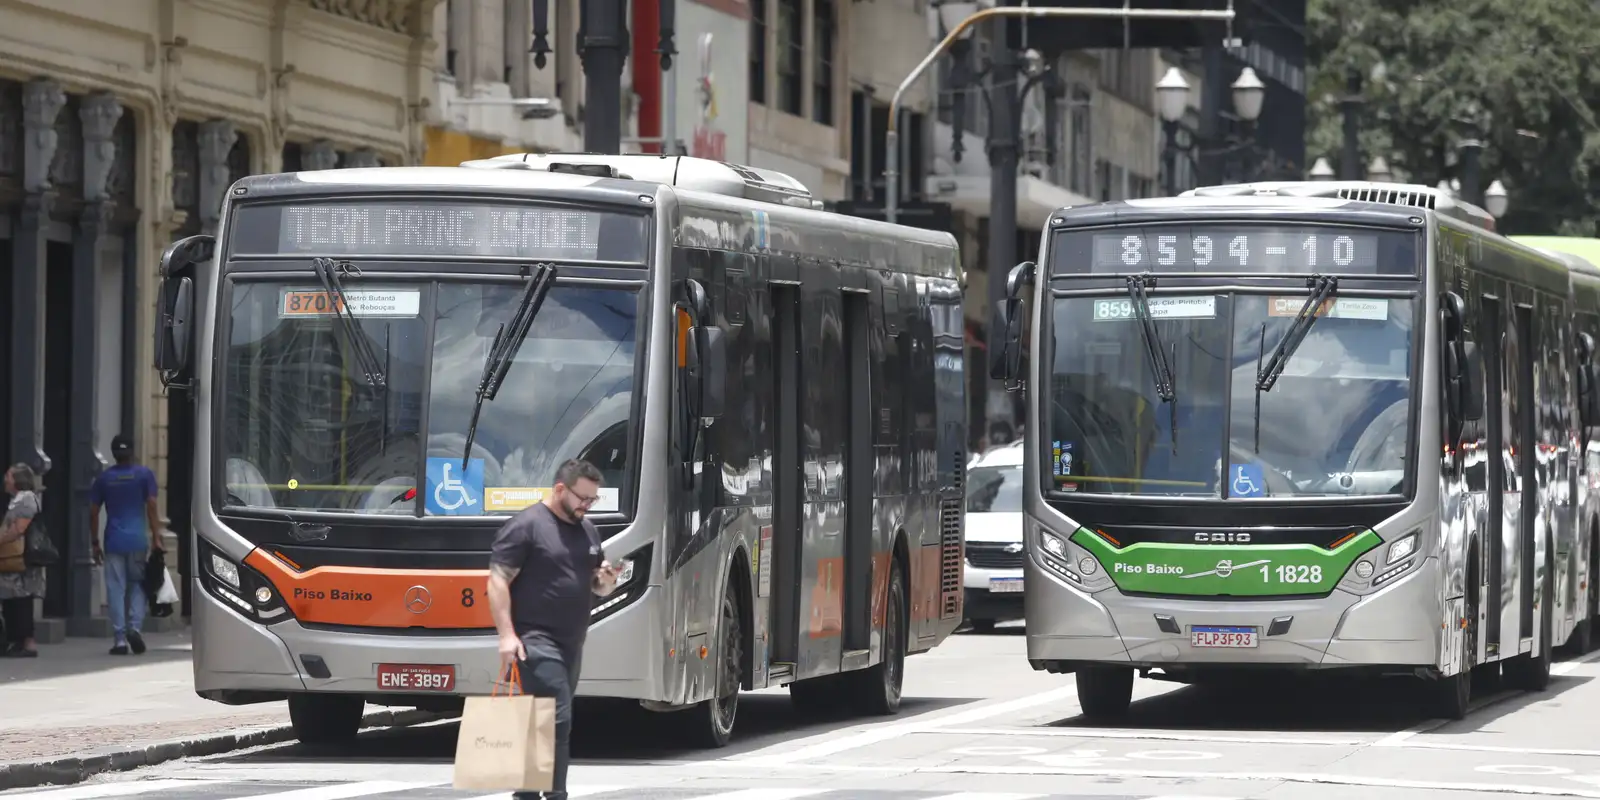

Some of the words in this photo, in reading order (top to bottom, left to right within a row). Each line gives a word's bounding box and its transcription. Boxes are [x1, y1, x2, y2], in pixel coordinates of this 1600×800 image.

[290, 207, 376, 245] TERM.
[385, 209, 481, 247] PRINC.
[490, 211, 598, 250] ISABEL
[1121, 235, 1354, 265] 8594-10
[1194, 532, 1251, 542] CAIO
[1114, 562, 1142, 574] Piso
[1146, 563, 1184, 575] Baixo
[1275, 565, 1322, 583] 1828
[293, 588, 325, 600] Piso
[330, 589, 373, 601] Baixo
[1197, 632, 1251, 646] FLP3F93
